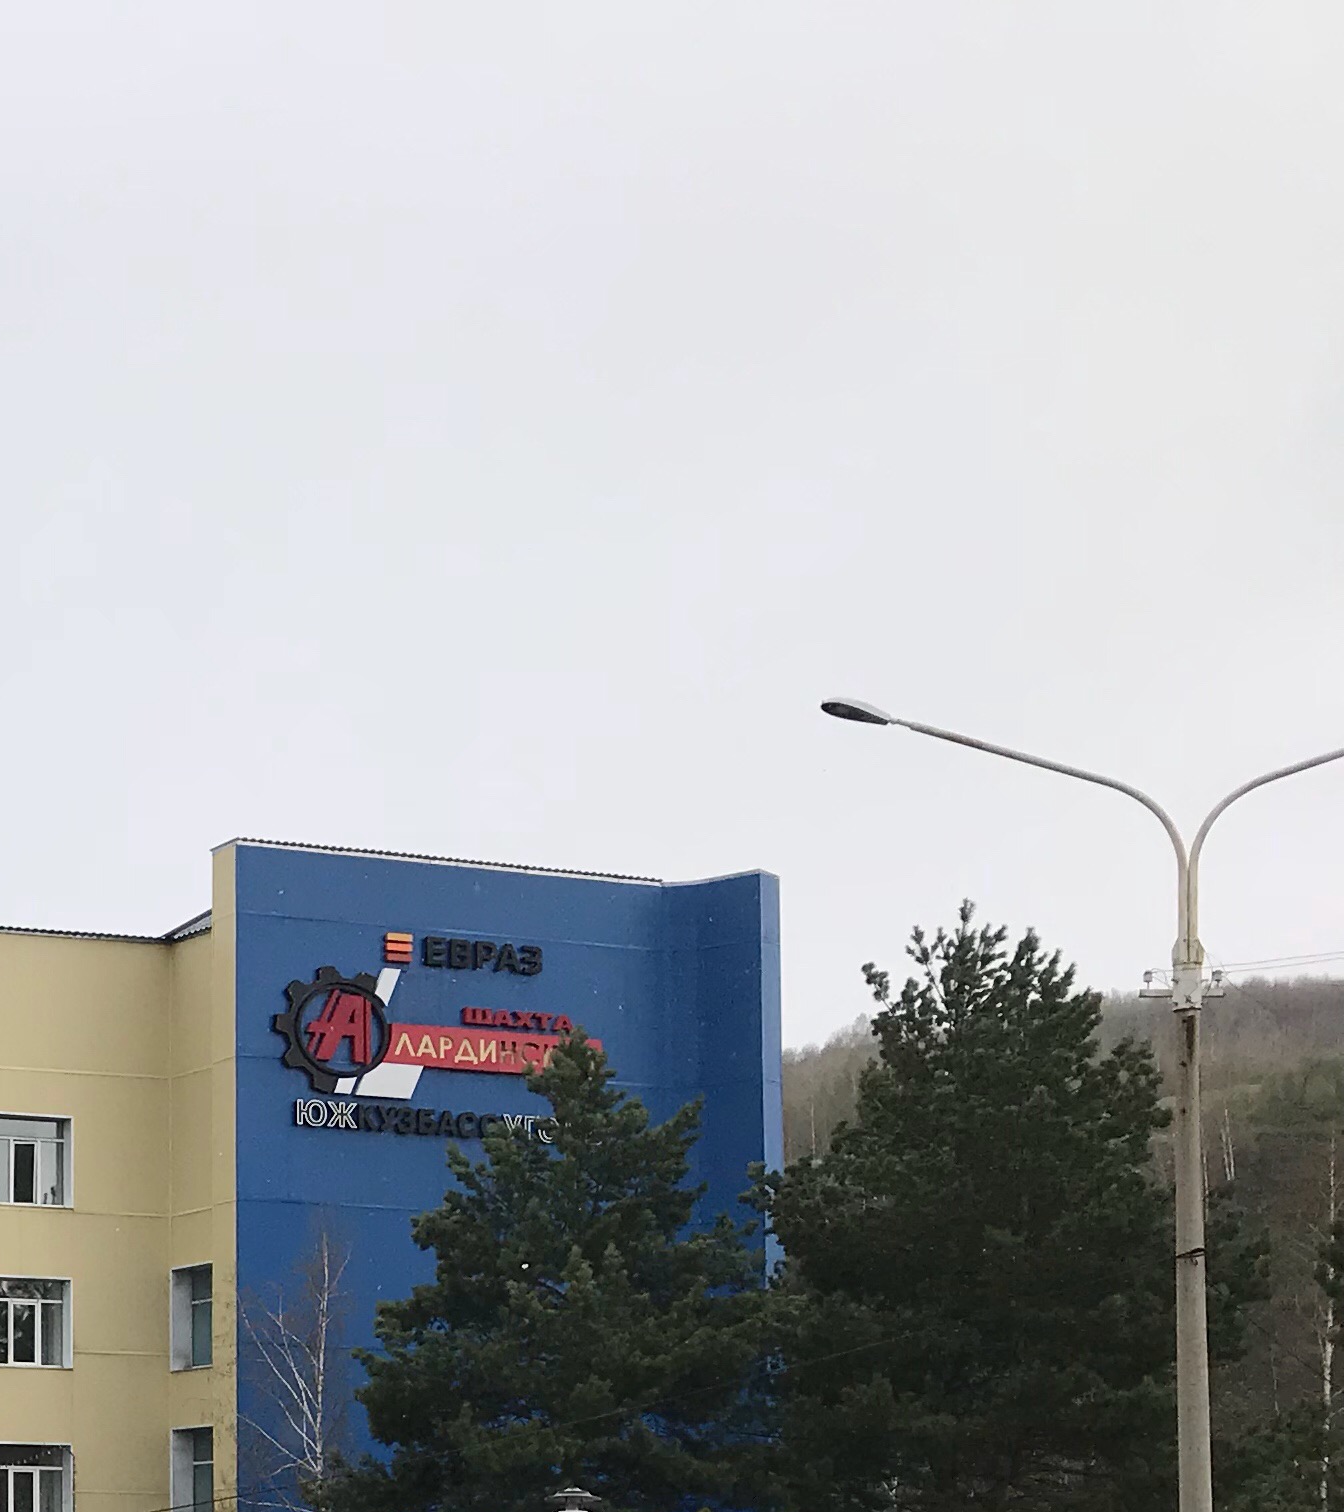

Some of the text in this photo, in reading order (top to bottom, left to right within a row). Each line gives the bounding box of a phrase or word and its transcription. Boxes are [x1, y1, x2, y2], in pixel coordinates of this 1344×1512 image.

[422, 936, 543, 976] ЕВРАЗ
[461, 1006, 573, 1034] ШАХТА
[394, 1032, 596, 1071] ЛАРДИНС
